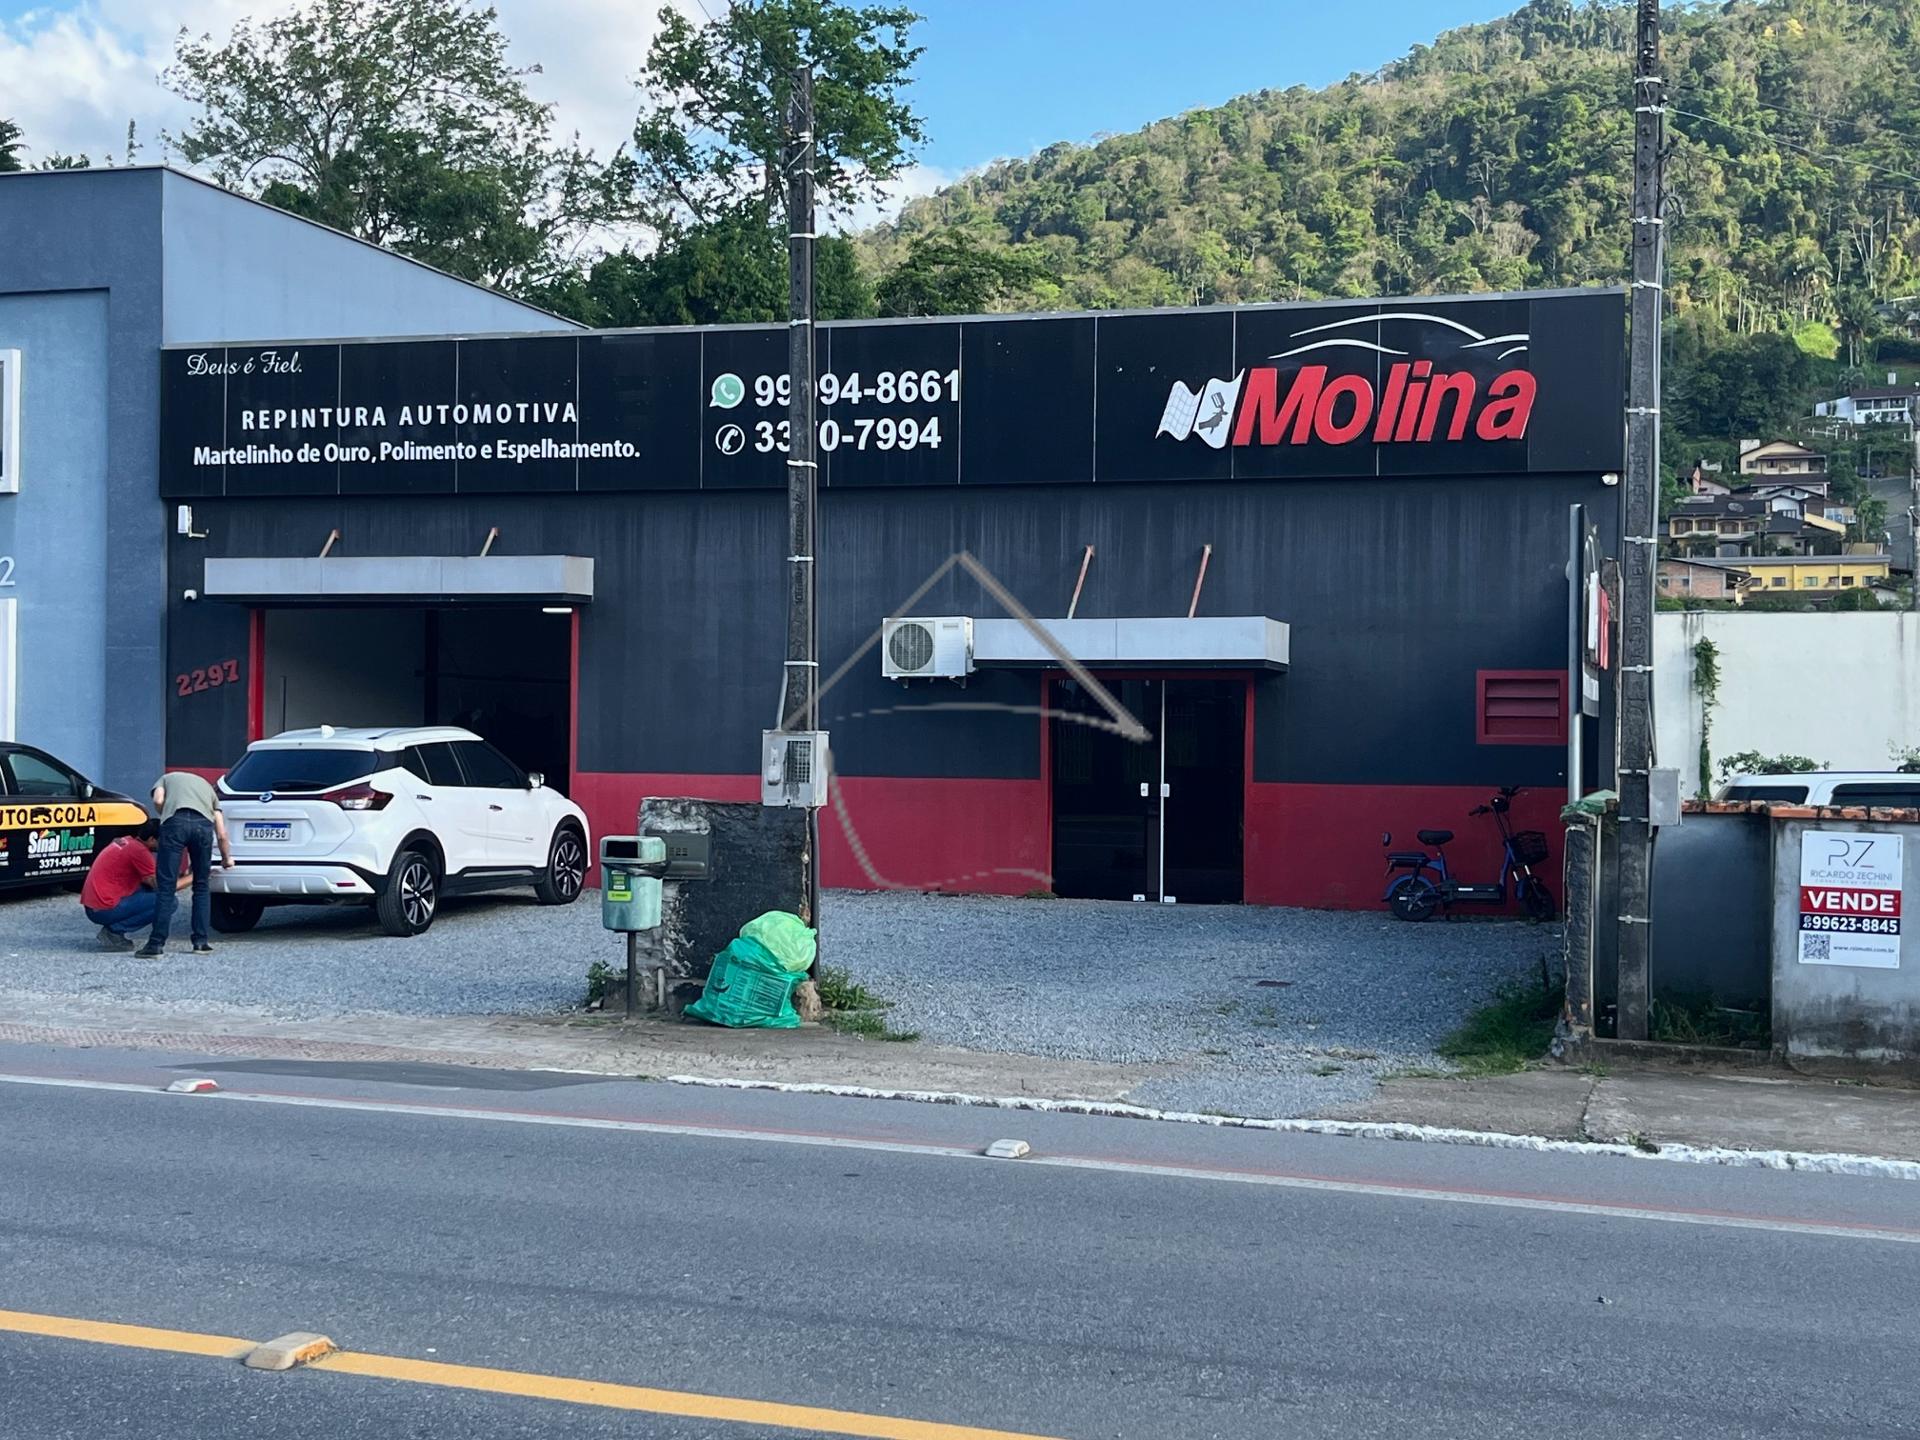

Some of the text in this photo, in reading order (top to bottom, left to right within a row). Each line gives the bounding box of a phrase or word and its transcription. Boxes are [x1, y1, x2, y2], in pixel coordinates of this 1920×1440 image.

[186, 352, 240, 376] Deus
[243, 356, 255, 375] é
[754, 369, 960, 407] 9994-8661
[242, 402, 578, 430] REPINTURA AUTOMOTIVA
[1232, 360, 1537, 446] Molina
[754, 416, 942, 452] 330-7994
[193, 437, 641, 466] Martelinho de Ouro, Polimento e Espelhamento.
[176, 660, 239, 696] 2297
[28, 831, 60, 854] Sinal
[1828, 839, 1875, 868] RZ
[1810, 870, 1893, 881] RICARDO ZECHINI
[1808, 890, 1895, 912] VENDE
[1812, 916, 1898, 933] 99623-8845
